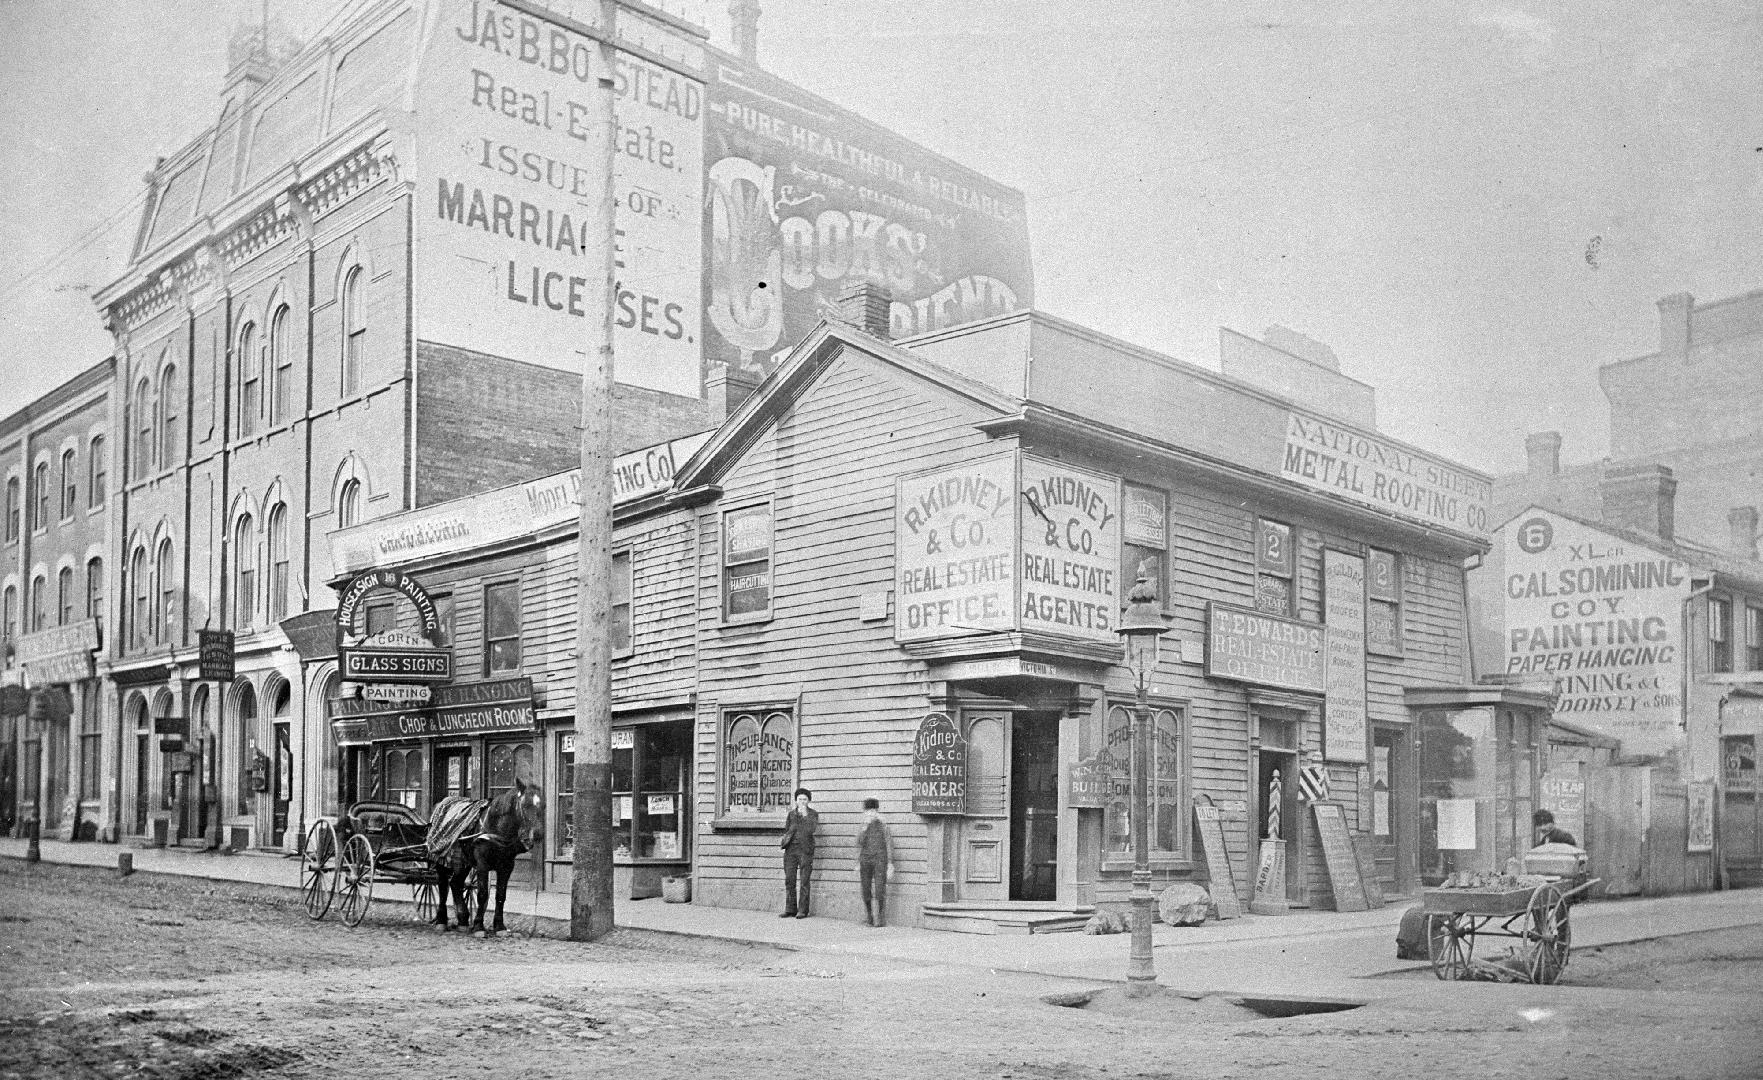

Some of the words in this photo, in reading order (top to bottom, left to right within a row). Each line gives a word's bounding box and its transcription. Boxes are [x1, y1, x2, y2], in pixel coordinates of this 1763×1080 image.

[549, 29, 702, 121] BOSTEAD
[471, 68, 684, 173] Real-Etate.
[479, 137, 619, 206] ISSUE
[628, 191, 663, 217] OF
[508, 261, 694, 343] LICESES.
[1292, 416, 1417, 477] NATIONAL
[1284, 443, 1364, 494] METAL
[1373, 472, 1459, 522] ROOFING
[525, 484, 568, 518] MODEL
[904, 506, 928, 534] R.
[921, 476, 1011, 519] KIDNEY
[1025, 486, 1047, 518] R.
[1041, 477, 1115, 530] KIDNEY
[927, 529, 941, 555] &
[1045, 520, 1061, 549] &
[1268, 535, 1280, 558] 2
[1526, 525, 1547, 548] 6
[903, 565, 942, 595] REAL
[947, 553, 1009, 588] ESTATE
[1024, 553, 1059, 586] REAL
[1063, 561, 1113, 596] ESTATE
[1377, 562, 1387, 585] 2
[1507, 559, 1684, 599] CALSOMINING
[339, 591, 356, 627] HOUSE
[355, 573, 379, 596] SIGN
[907, 593, 1006, 629] OFFICE.
[1023, 592, 1113, 632] AGENTS.
[1233, 614, 1319, 649] EDWARDS
[1510, 616, 1667, 652] PAINTING
[351, 657, 399, 671] GLASS
[1507, 652, 1573, 675] PAPER
[1577, 645, 1675, 668] HANGING
[366, 688, 428, 698] PAINTING
[460, 682, 527, 705] HANGING
[1559, 695, 1639, 713] DORSEY
[399, 715, 427, 734] CHOP
[429, 721, 438, 731] &
[437, 711, 494, 732] LUNCHEON
[494, 707, 533, 728] ROOMS
[731, 733, 792, 760] INSURANCE
[919, 729, 957, 756] Kidney
[935, 749, 946, 760] &
[736, 760, 759, 773] LOAN
[763, 759, 792, 771] AGENTS
[930, 763, 964, 777] ESTATE
[729, 792, 792, 806] NEGOTIATED
[912, 781, 965, 797] BROKERS
